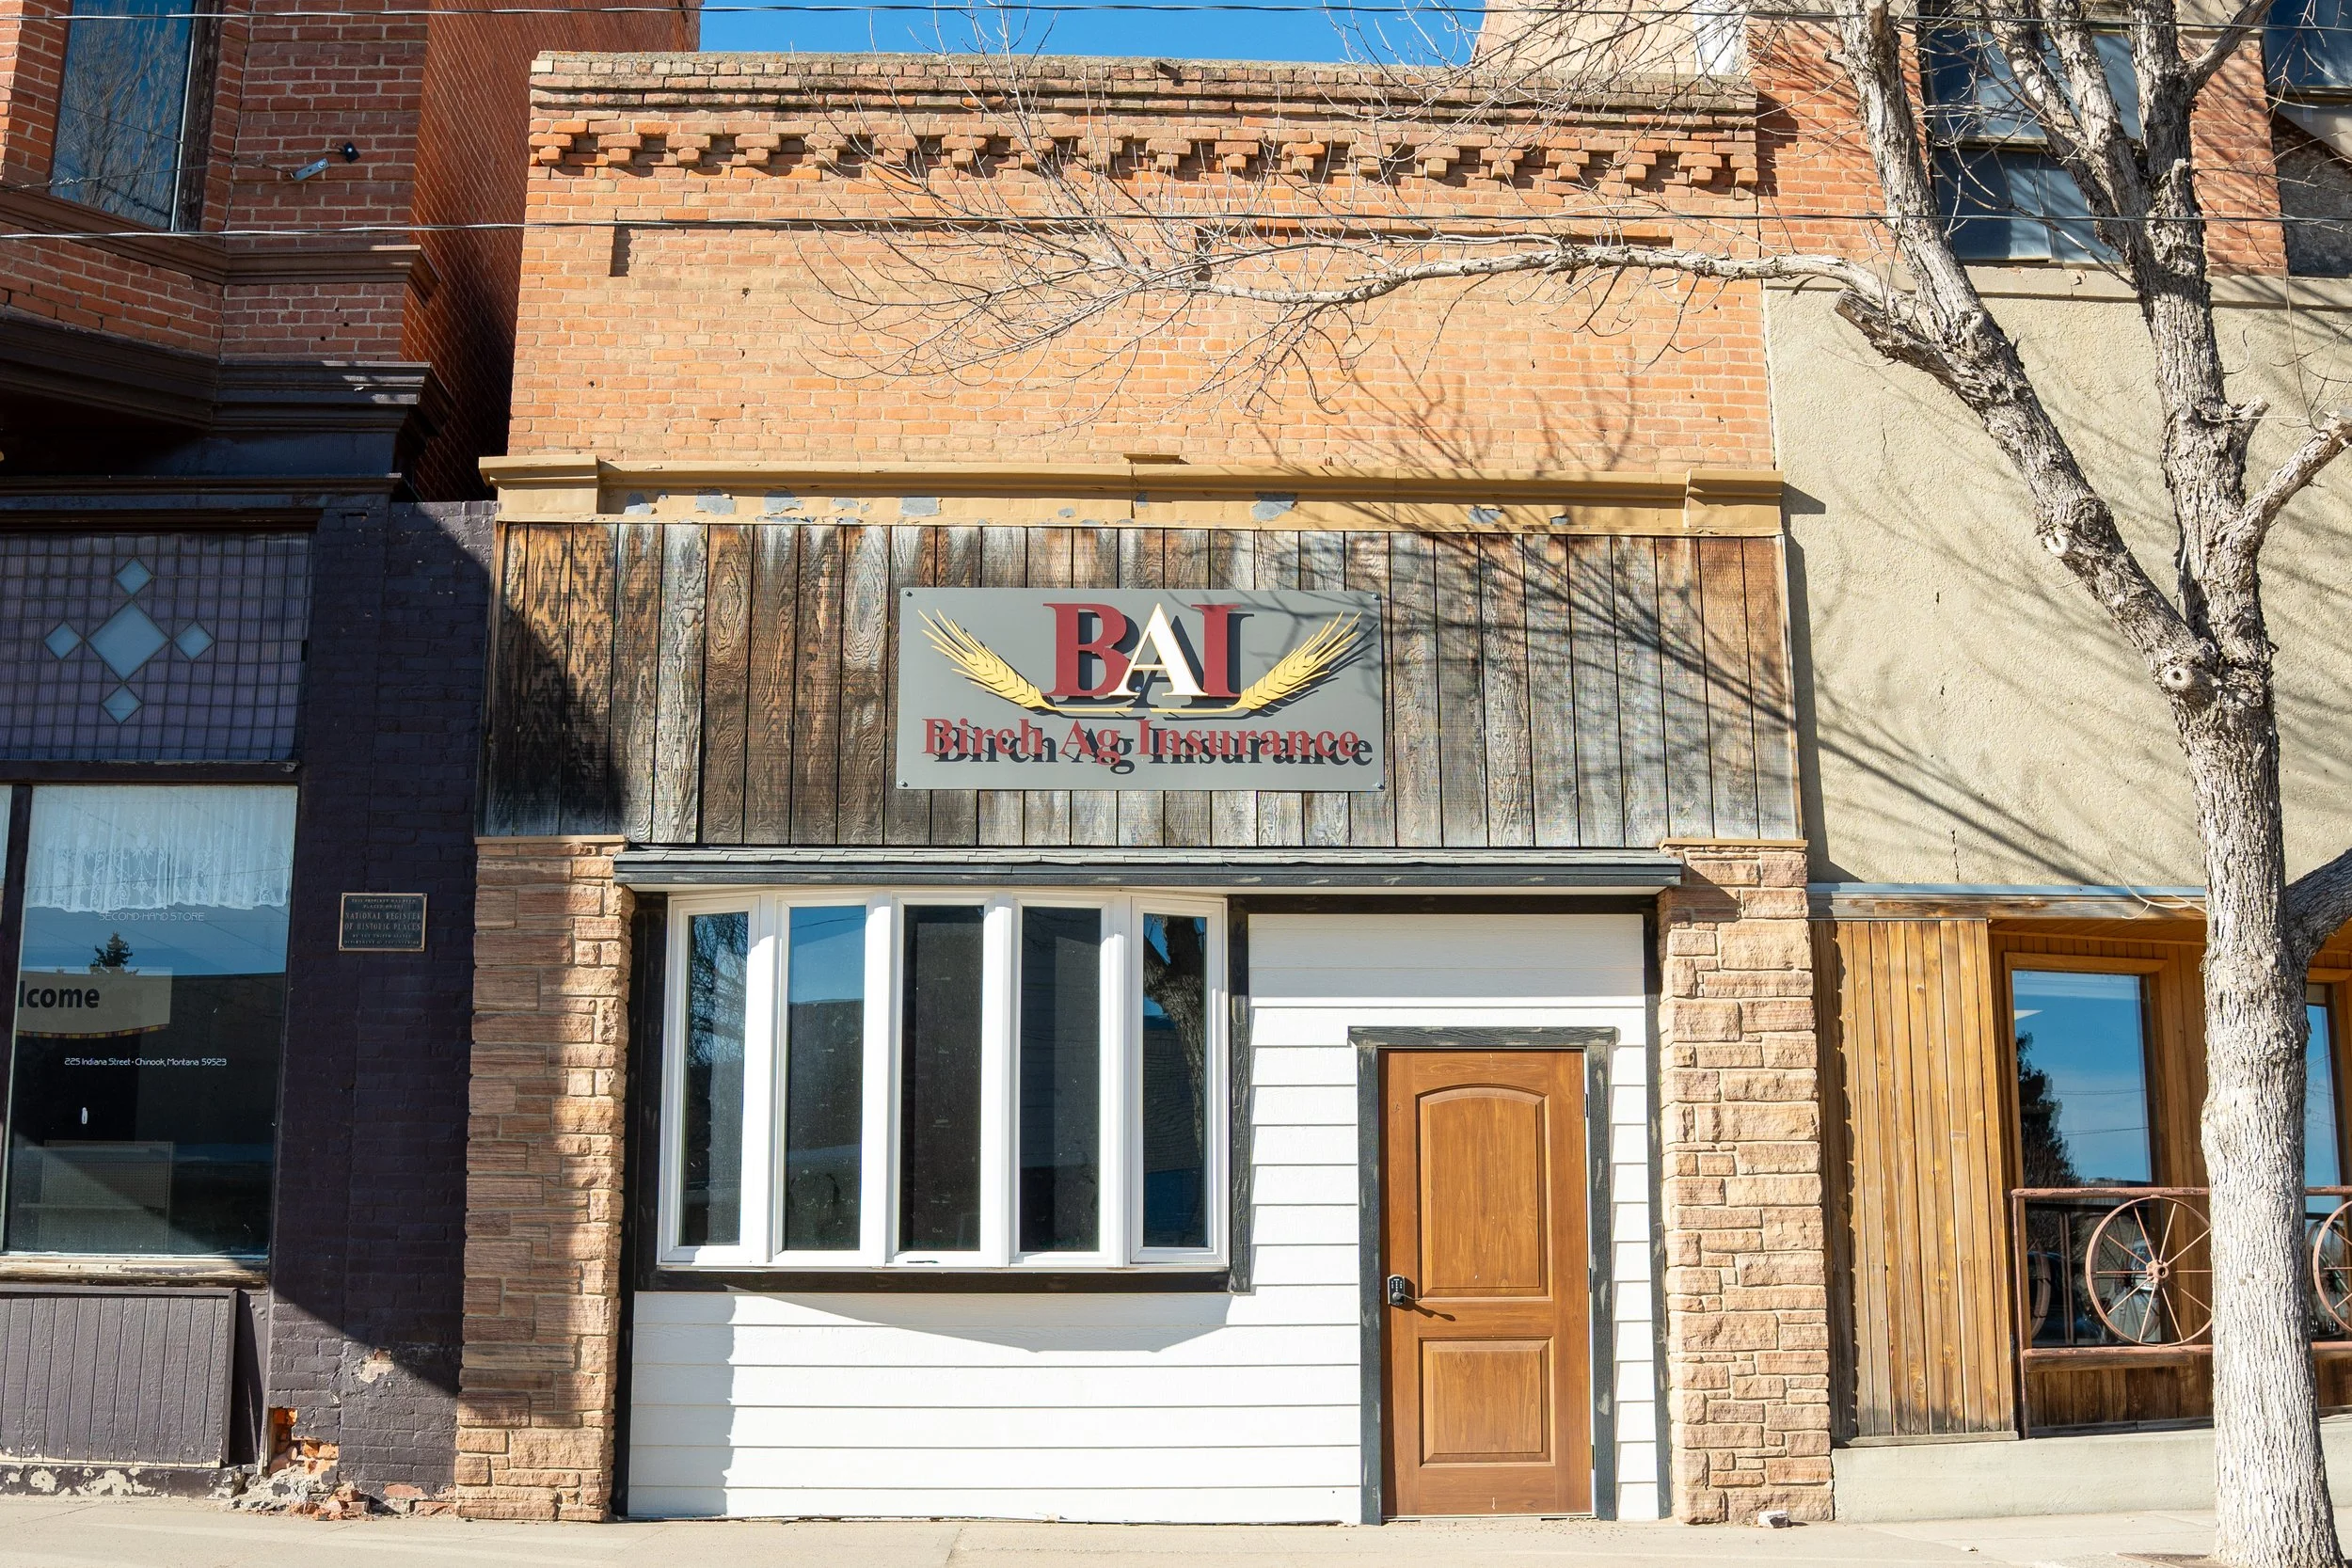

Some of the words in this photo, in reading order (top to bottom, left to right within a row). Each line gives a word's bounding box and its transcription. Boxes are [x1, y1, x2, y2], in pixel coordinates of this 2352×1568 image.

[1042, 602, 1243, 698] BAI
[922, 718, 1044, 756] Birch
[1059, 719, 1121, 766] Ag
[1136, 720, 1359, 758] Insurance
[170, 911, 205, 921] STORE
[345, 911, 381, 920] NATIONAL
[386, 911, 421, 920] REGISTER
[357, 922, 390, 930] HISTORIC
[19, 980, 100, 1008] lcome
[64, 1057, 81, 1066] 225
[82, 1057, 107, 1066] Indiana
[108, 1057, 131, 1066] Street
[135, 1057, 167, 1067] Chinook,
[167, 1057, 199, 1066] Montana
[201, 1057, 227, 1066] 59523
